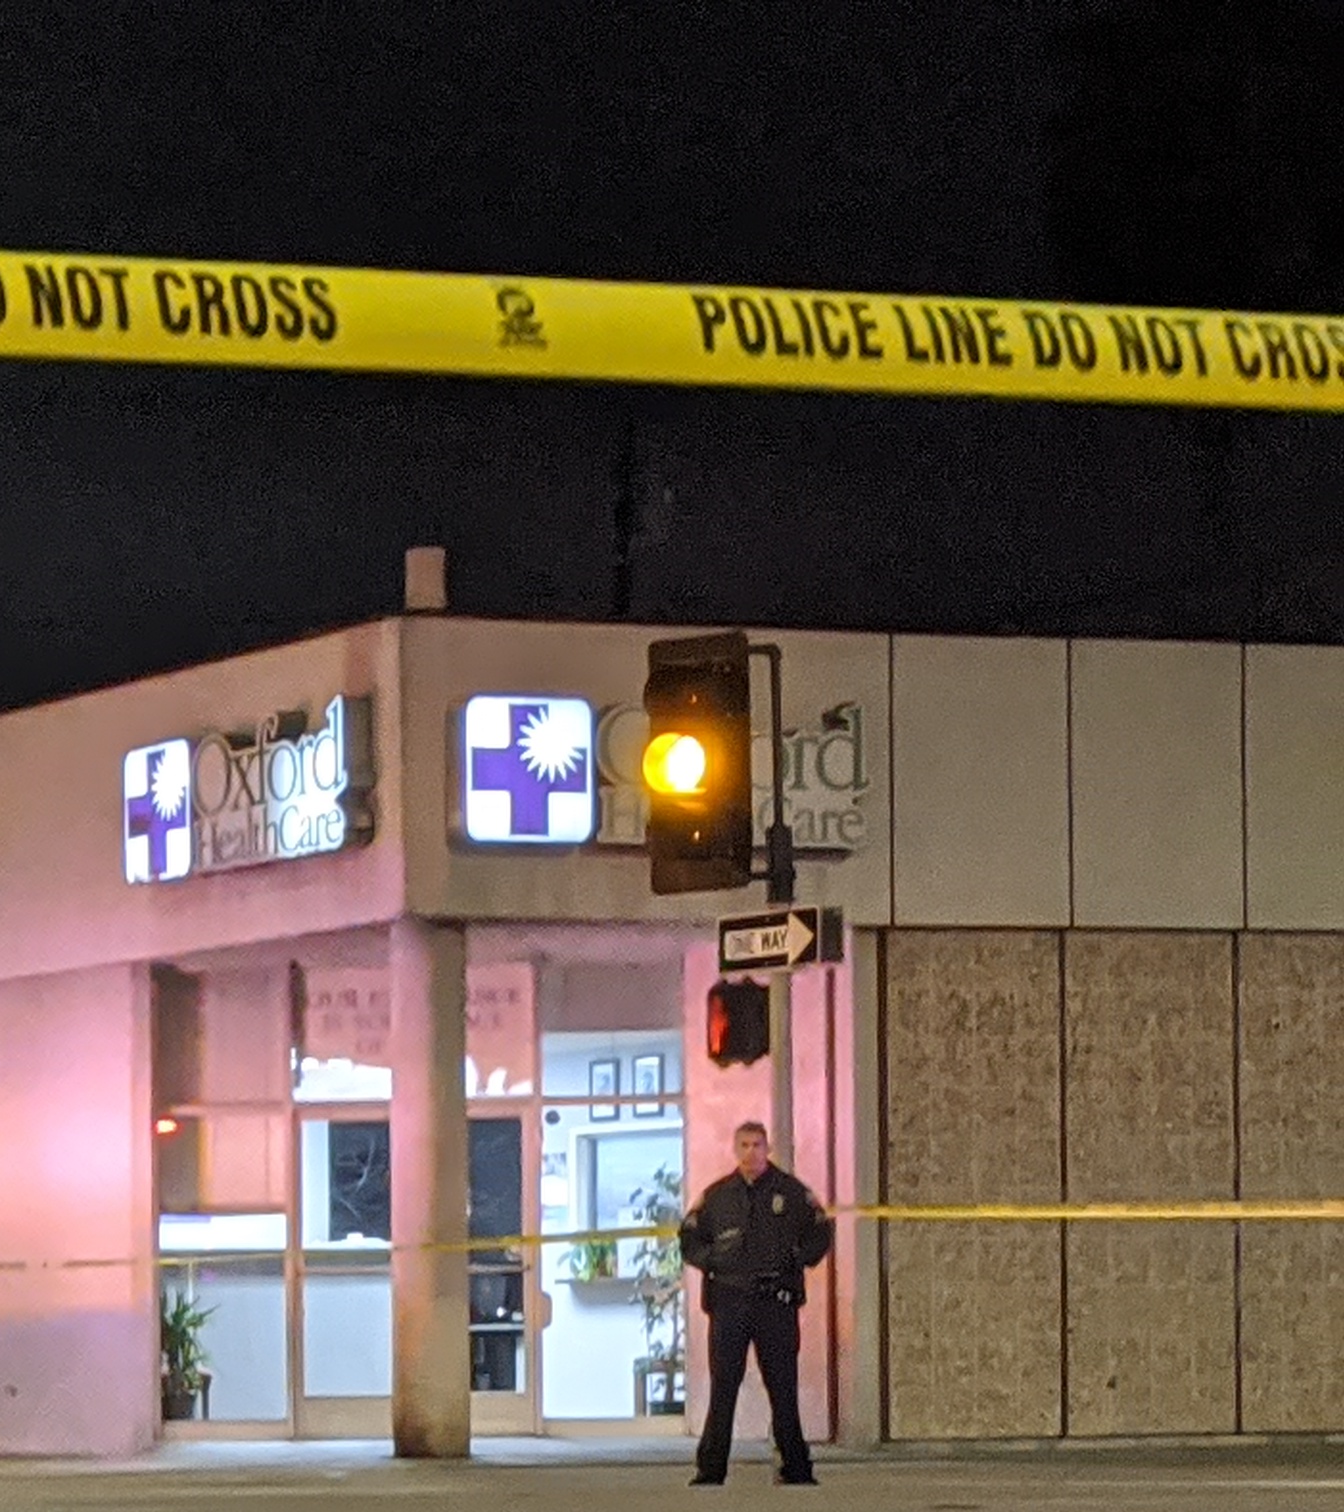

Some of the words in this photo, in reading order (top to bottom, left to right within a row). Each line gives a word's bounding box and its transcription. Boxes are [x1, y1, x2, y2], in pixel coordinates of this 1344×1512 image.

[25, 264, 130, 331] NOT
[153, 270, 338, 341] CROSS
[691, 294, 884, 359] POLICE
[892, 304, 1013, 366] LINE
[1022, 309, 1097, 372] DO
[1108, 314, 1208, 378] NOT
[193, 696, 345, 817] Oxford
[597, 702, 869, 791] Oord
[761, 929, 788, 952] WAY
